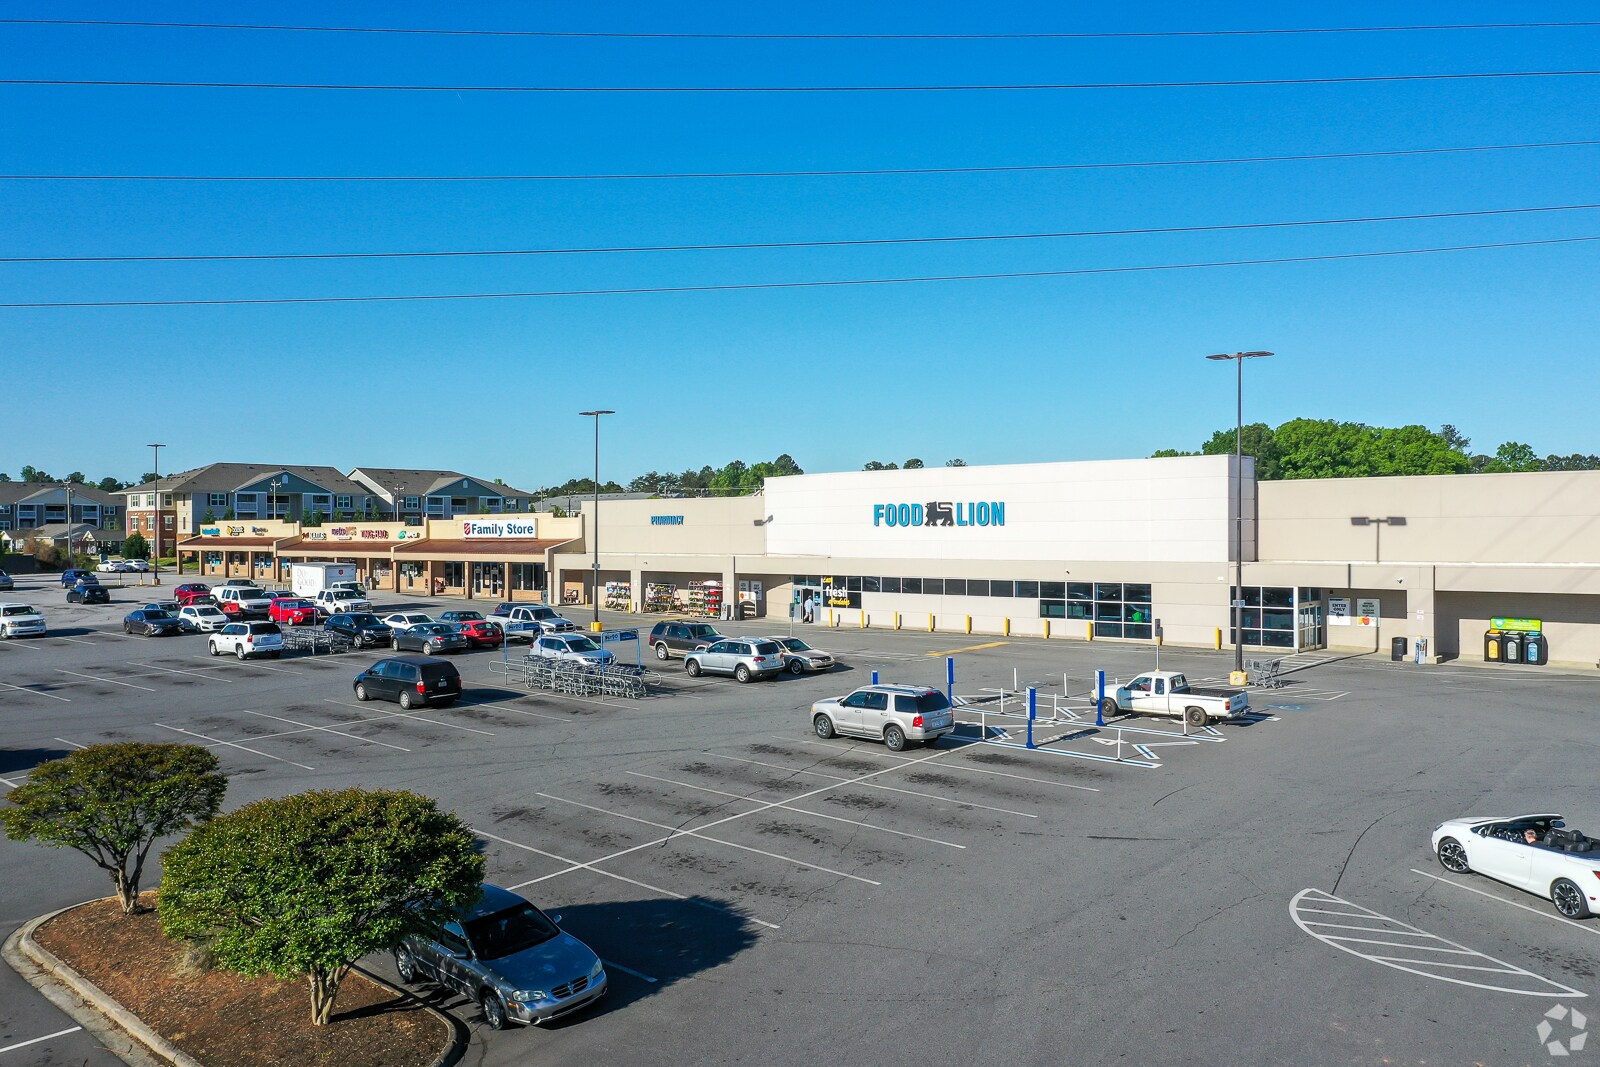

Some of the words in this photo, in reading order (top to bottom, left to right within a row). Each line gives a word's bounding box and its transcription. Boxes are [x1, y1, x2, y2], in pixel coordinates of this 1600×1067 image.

[650, 515, 684, 525] PHARMACY
[873, 503, 923, 527] FOOD
[956, 501, 1005, 527] LION
[471, 523, 504, 537] Family
[506, 523, 534, 534] Store
[826, 586, 847, 597] fresh
